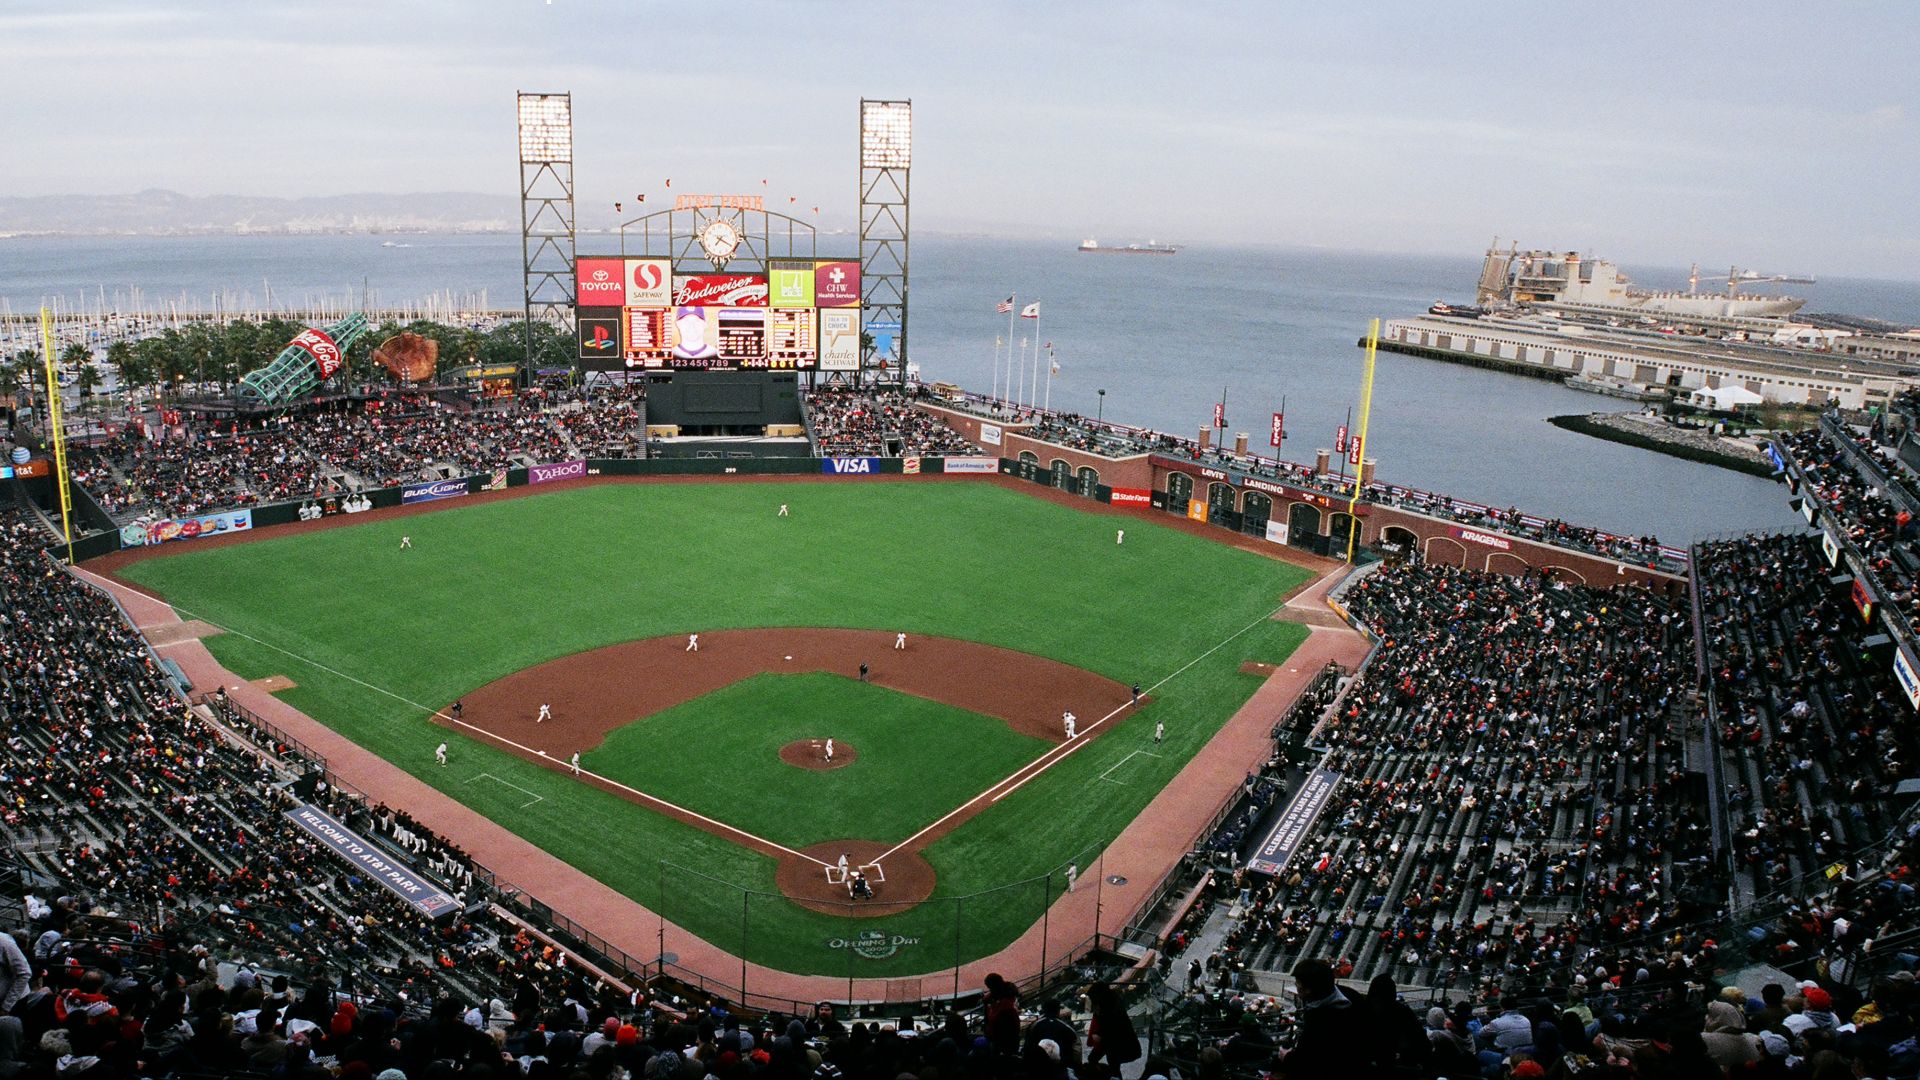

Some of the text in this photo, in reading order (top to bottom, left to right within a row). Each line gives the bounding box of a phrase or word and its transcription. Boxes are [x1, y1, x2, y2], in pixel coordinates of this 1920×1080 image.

[704, 251, 737, 264] GIANTS
[581, 282, 621, 291] TOYOTA
[675, 276, 753, 305] Budweiser
[826, 284, 848, 292] CHW
[824, 349, 855, 359] charles
[533, 463, 582, 482] YAHOO!
[832, 459, 870, 473] VISA
[403, 482, 467, 498] BUD LIGHT
[1244, 478, 1284, 494] LANDING
[1120, 493, 1134, 501] State
[1461, 530, 1499, 547] KRAGEN
[1264, 818, 1293, 855] CELEBRATING
[1293, 797, 1308, 815] YEARS
[1303, 790, 1313, 799] OF
[1308, 774, 1324, 792] GIANTS
[1280, 825, 1303, 851] BASEBALL
[1301, 807, 1312, 819] SAN
[1308, 782, 1330, 809] FRANCISCO
[300, 810, 422, 894] WELCOME TO AT&T PARK
